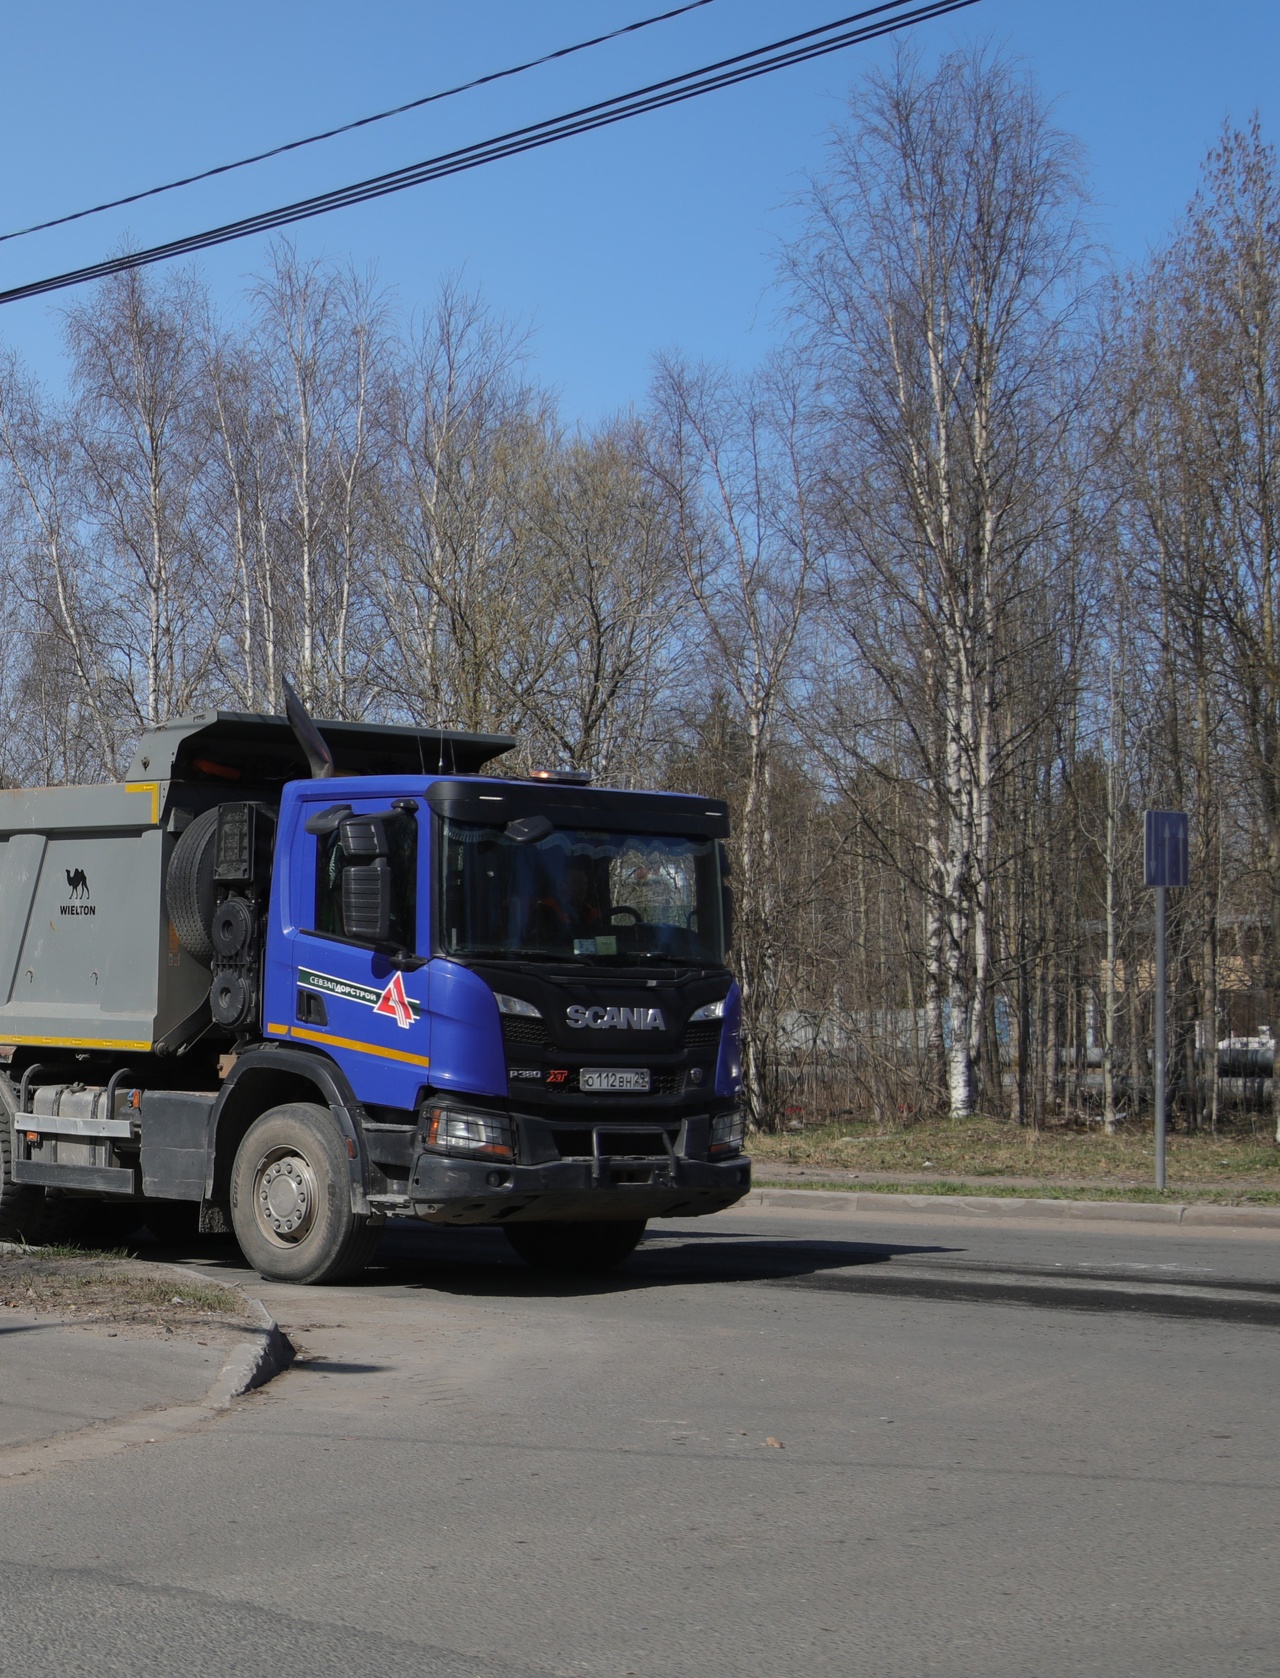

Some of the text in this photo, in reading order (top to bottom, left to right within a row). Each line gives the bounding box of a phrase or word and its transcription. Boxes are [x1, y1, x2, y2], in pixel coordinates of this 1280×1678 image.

[60, 905, 96, 916] WIELTON
[309, 976, 377, 1001] СЕВЗАПДОРСТРОЙ
[566, 1005, 666, 1031] SCANIA
[546, 1070, 568, 1083] XT
